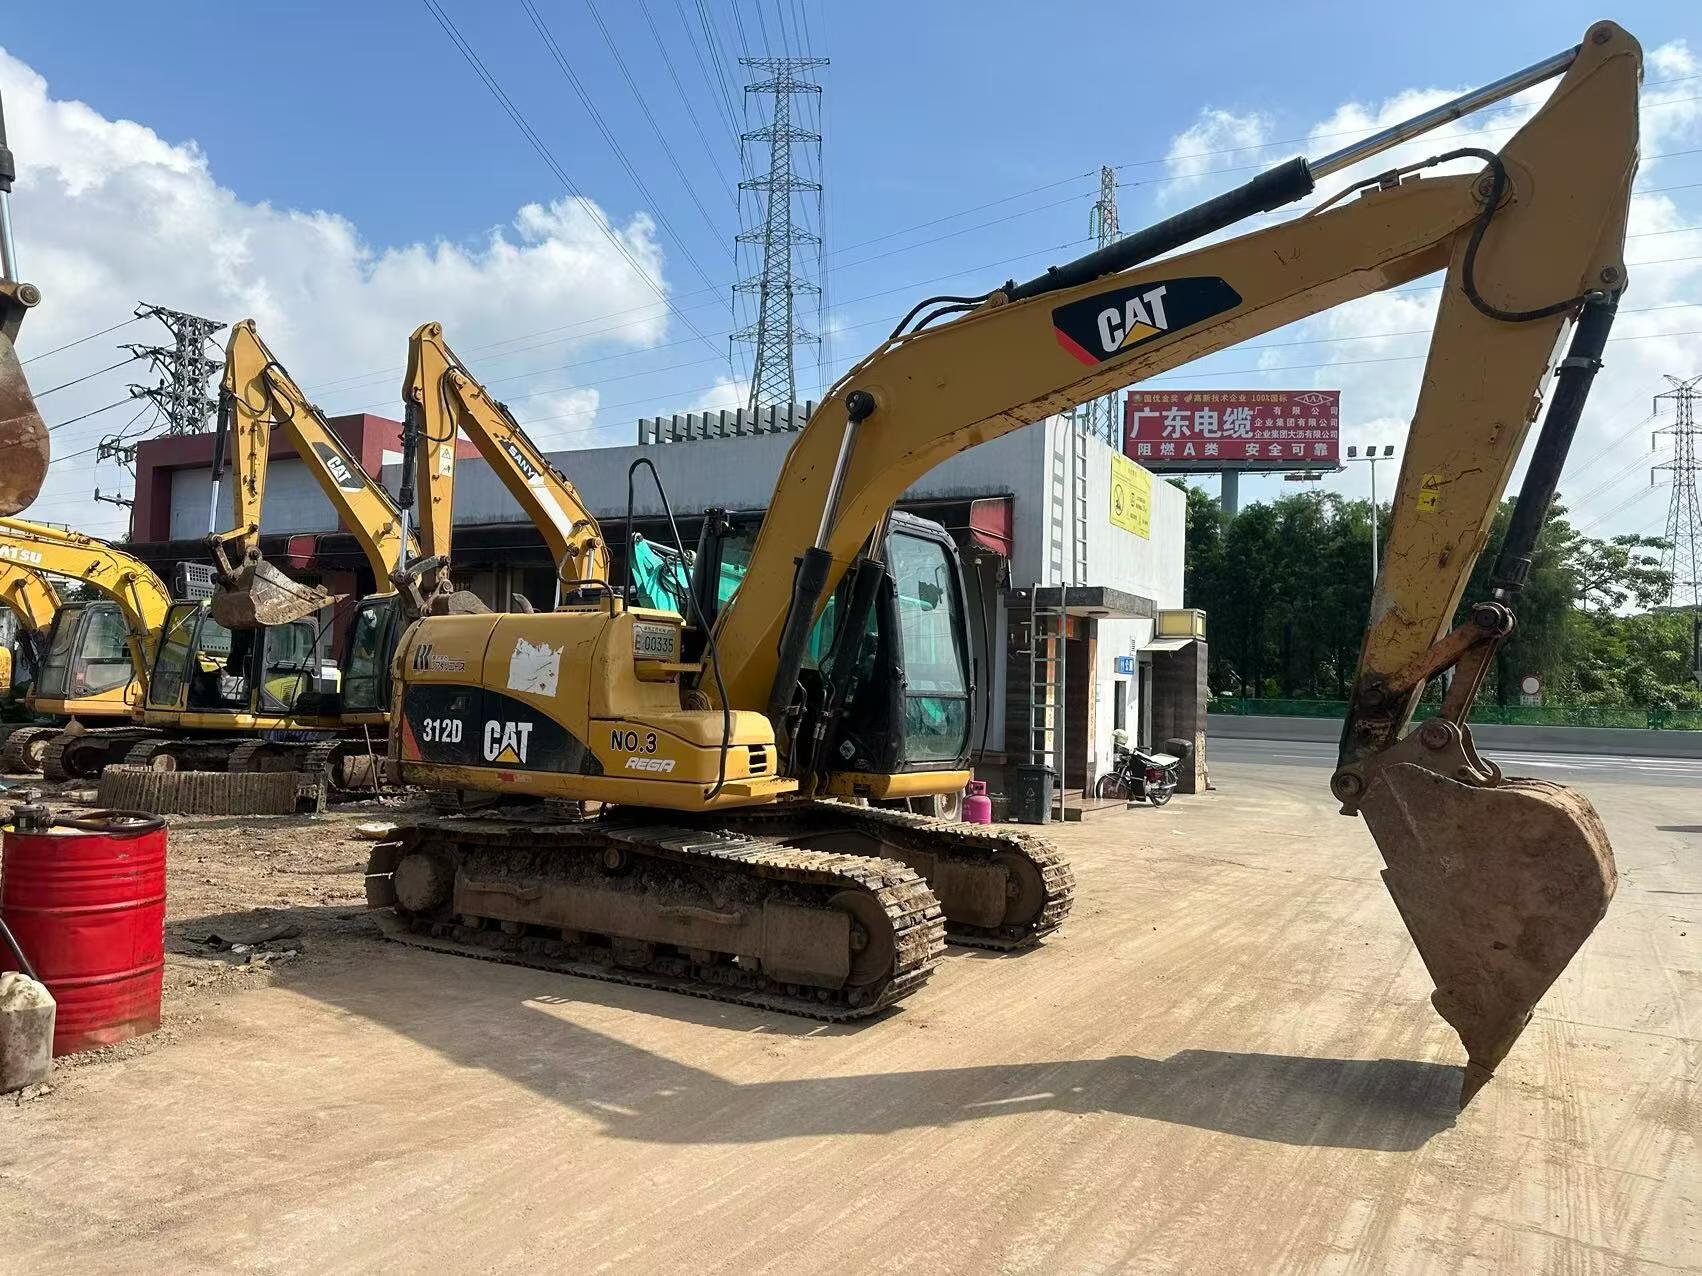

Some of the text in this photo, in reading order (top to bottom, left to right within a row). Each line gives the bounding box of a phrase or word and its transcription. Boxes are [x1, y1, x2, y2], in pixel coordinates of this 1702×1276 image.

[1097, 285, 1168, 352] CAT
[1129, 406, 1254, 438] 广东电缆
[1254, 418, 1338, 427] 企业集团有限公司
[508, 445, 536, 477] SANY
[1245, 442, 1329, 457] 安全可靠
[326, 455, 352, 483] CAT
[644, 635, 674, 653] 00335
[422, 718, 463, 743] 312D
[483, 719, 533, 764] CAT
[610, 728, 658, 754] NO.3
[624, 756, 676, 773] REGA
